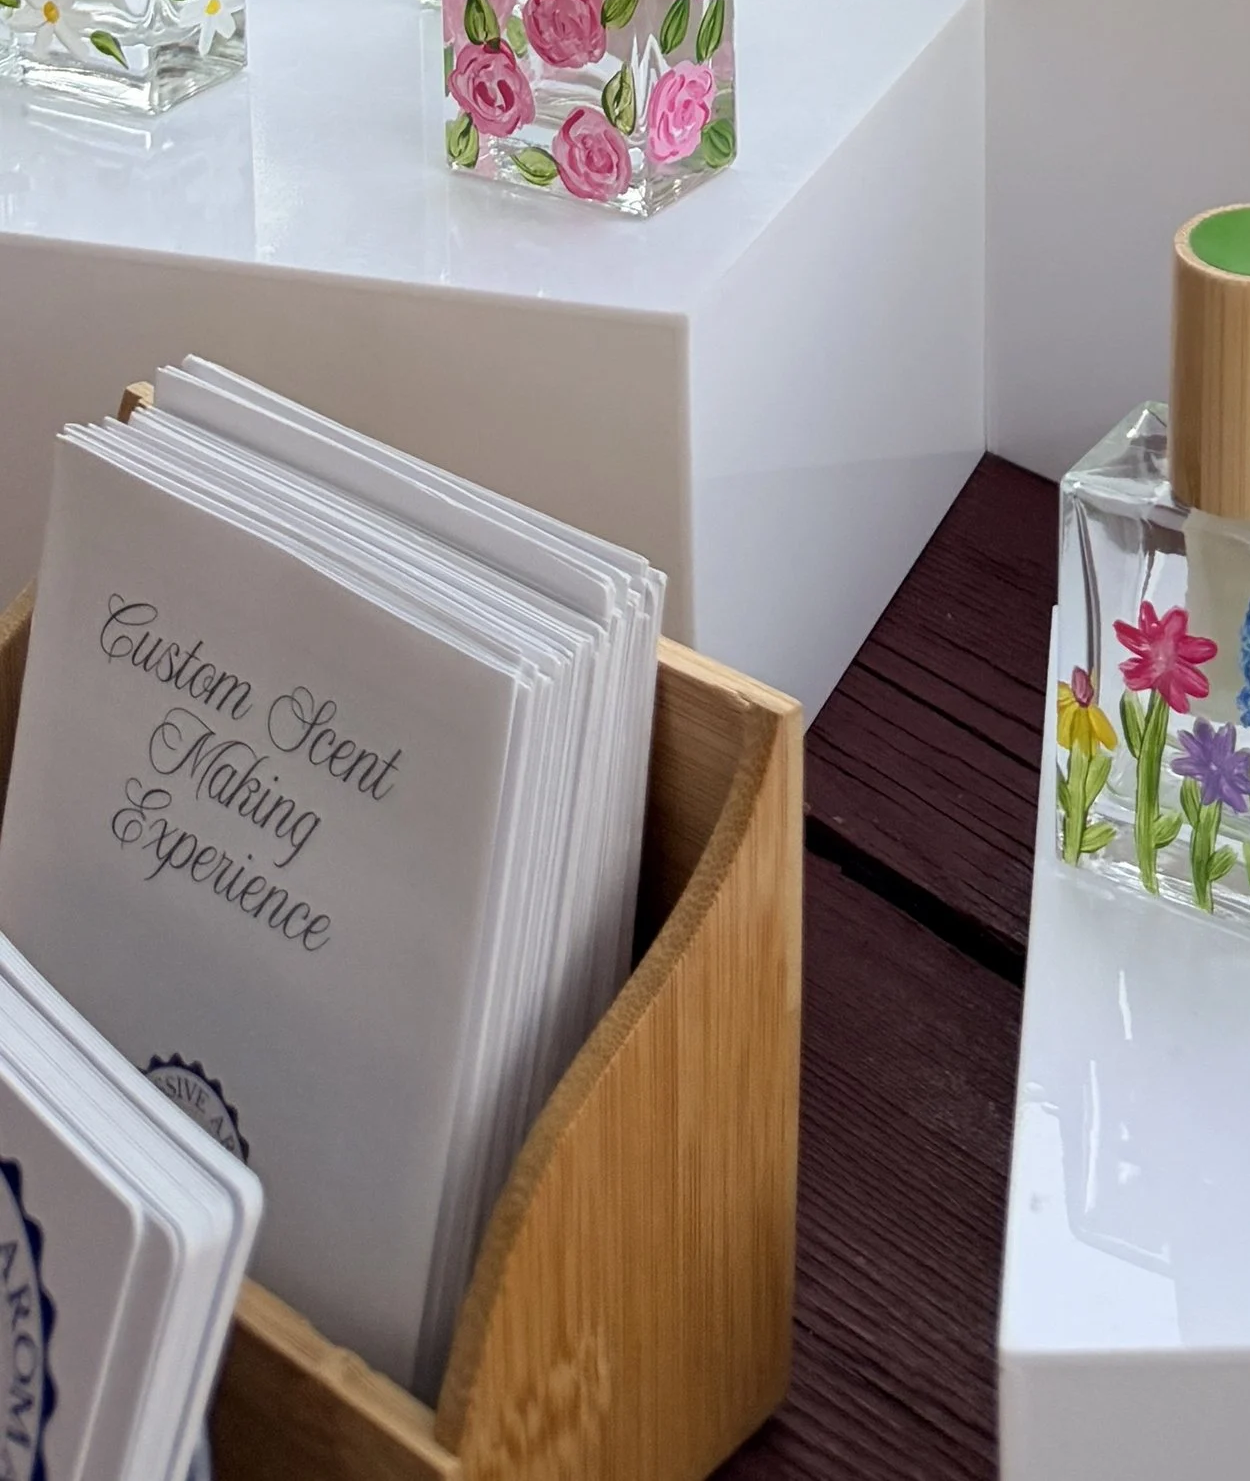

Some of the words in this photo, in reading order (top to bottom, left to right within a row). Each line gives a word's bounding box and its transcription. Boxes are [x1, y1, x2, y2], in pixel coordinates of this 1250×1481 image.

[100, 593, 253, 720] Custom
[267, 685, 402, 801] Scent
[111, 777, 332, 951] Experience
[149, 707, 322, 869] Making
